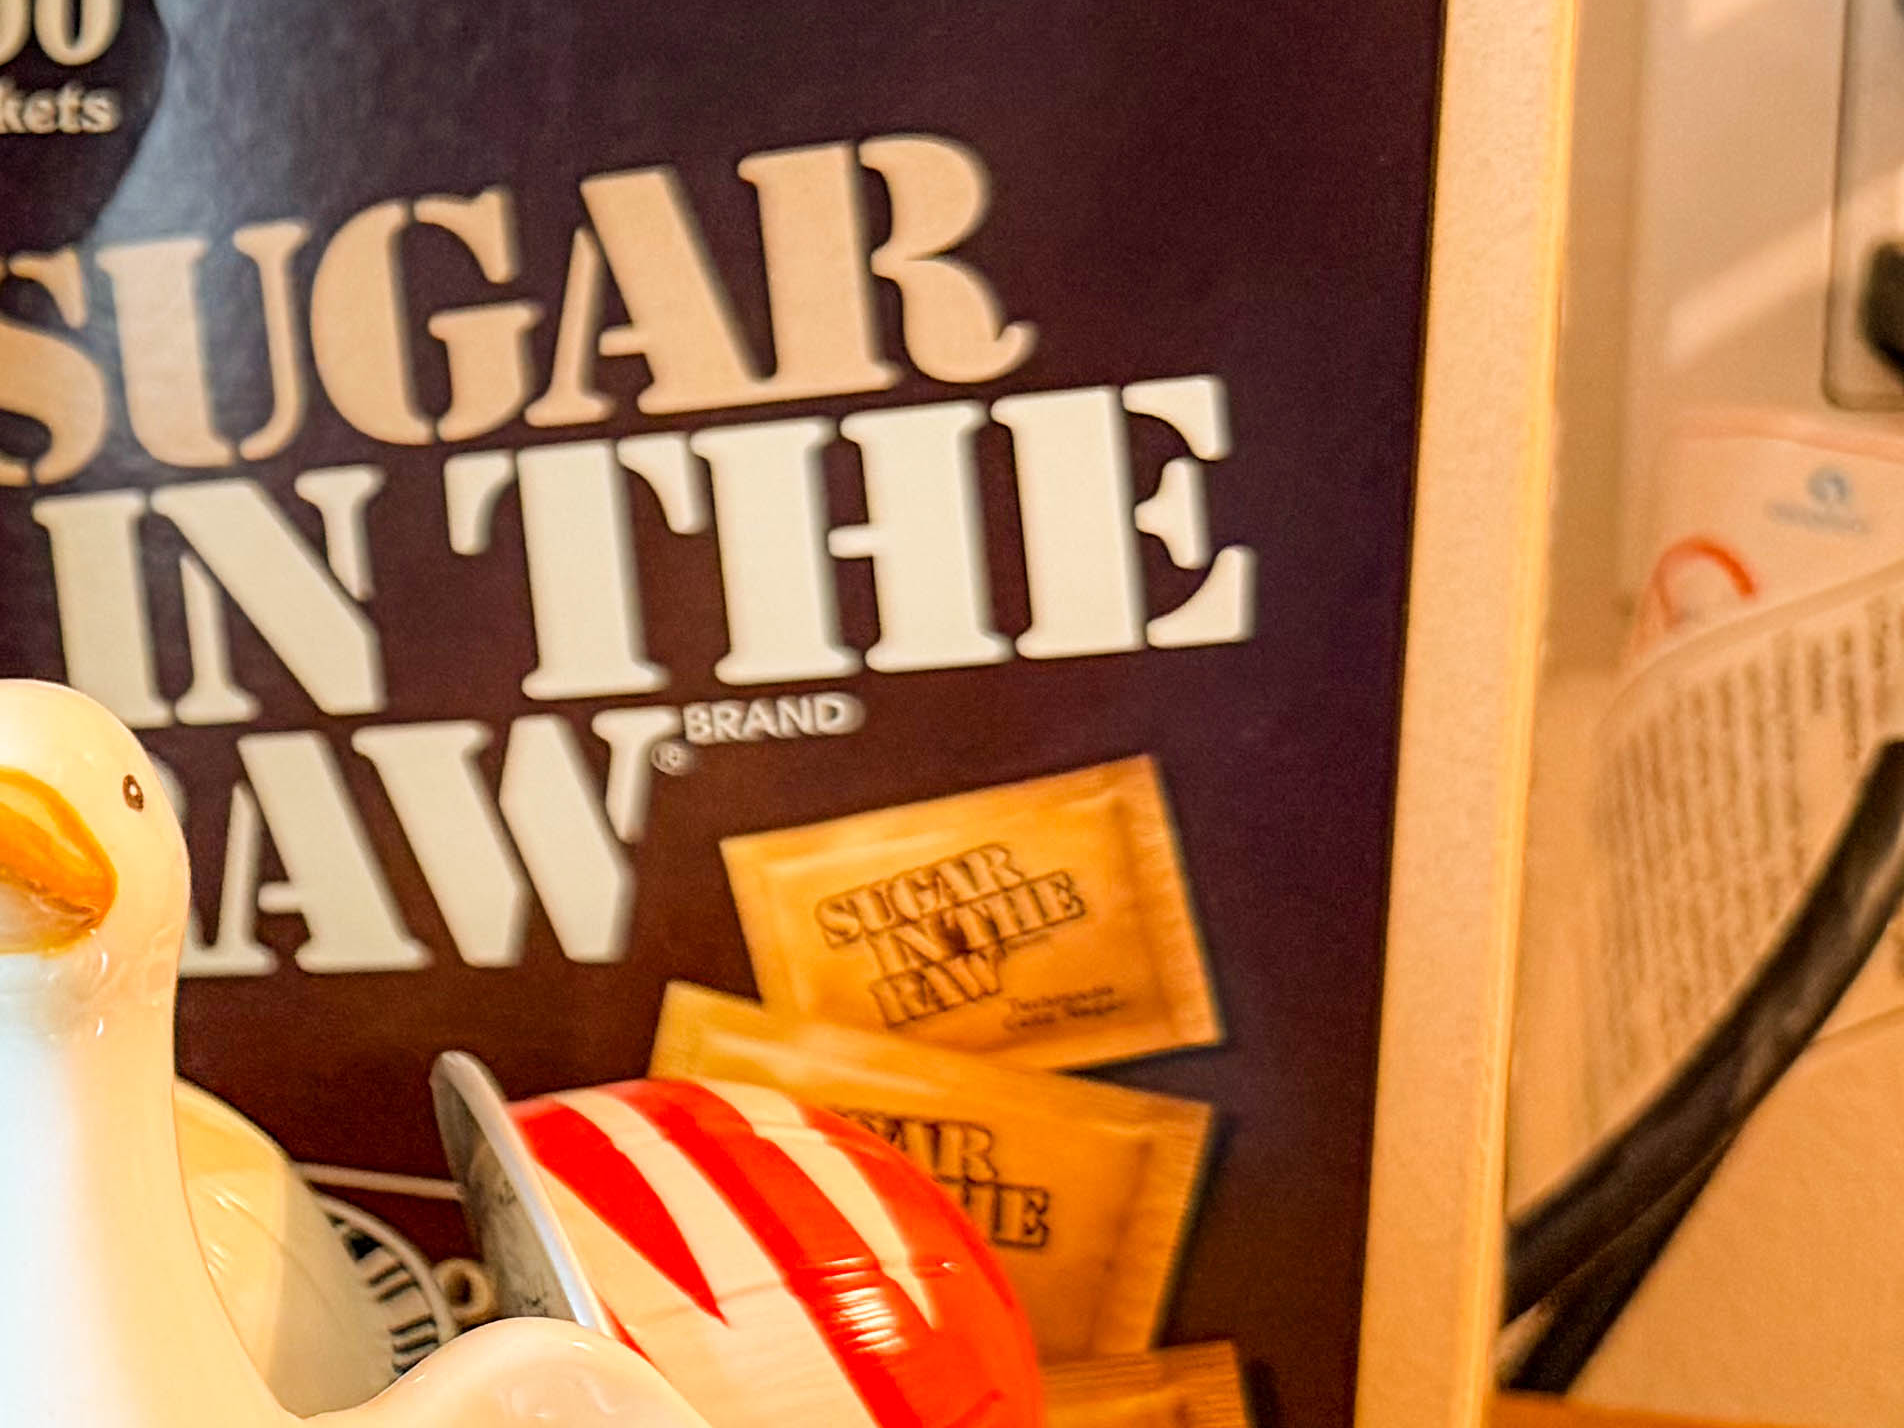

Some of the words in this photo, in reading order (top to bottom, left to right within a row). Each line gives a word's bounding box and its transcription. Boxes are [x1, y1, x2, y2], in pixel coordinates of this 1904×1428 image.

[33, 465, 387, 728] IN
[445, 375, 1258, 701] THE
[682, 691, 868, 746] BRAND
[156, 706, 682, 978] AW
[814, 842, 1026, 950] SUGAR
